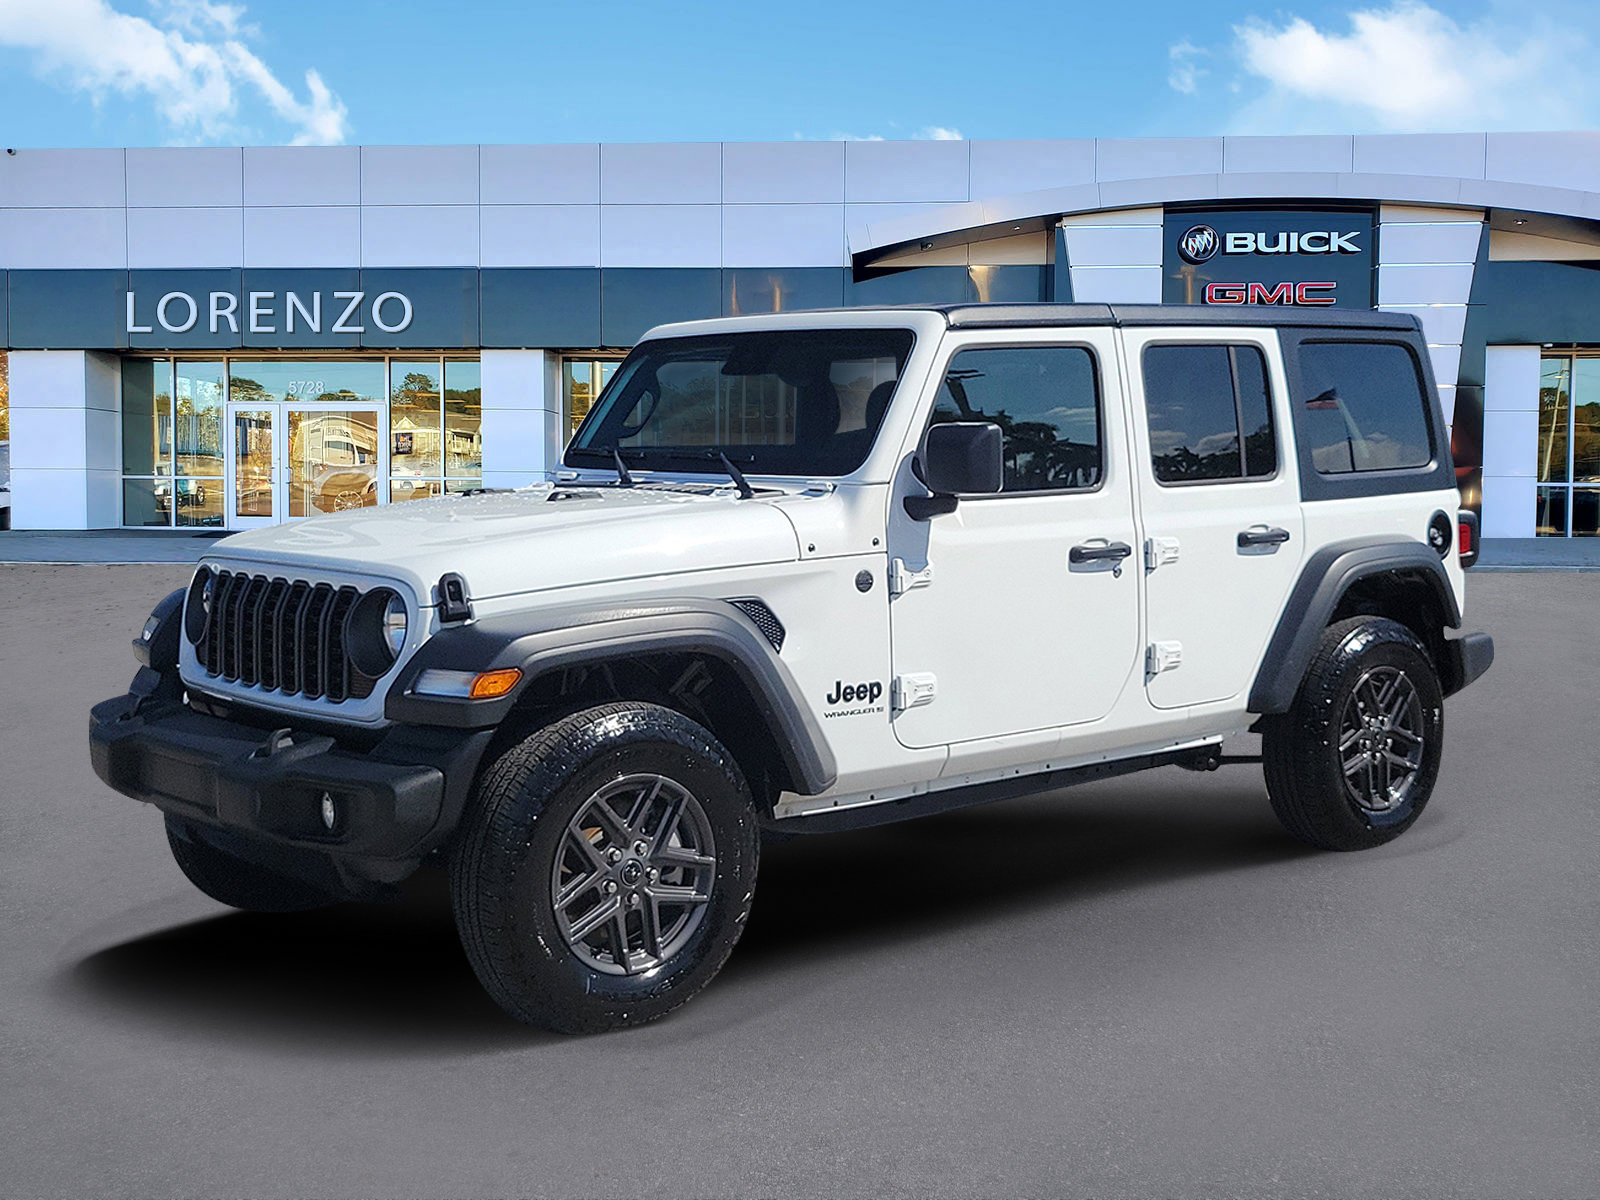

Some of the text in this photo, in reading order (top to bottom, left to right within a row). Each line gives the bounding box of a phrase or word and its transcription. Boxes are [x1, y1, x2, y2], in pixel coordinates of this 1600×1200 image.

[1225, 231, 1362, 253] BUICK
[1205, 282, 1336, 305] GMC
[126, 291, 413, 333] LORENZO
[288, 381, 325, 395] 5728
[826, 680, 882, 704] Jeep
[823, 707, 875, 718] WRANGLER
